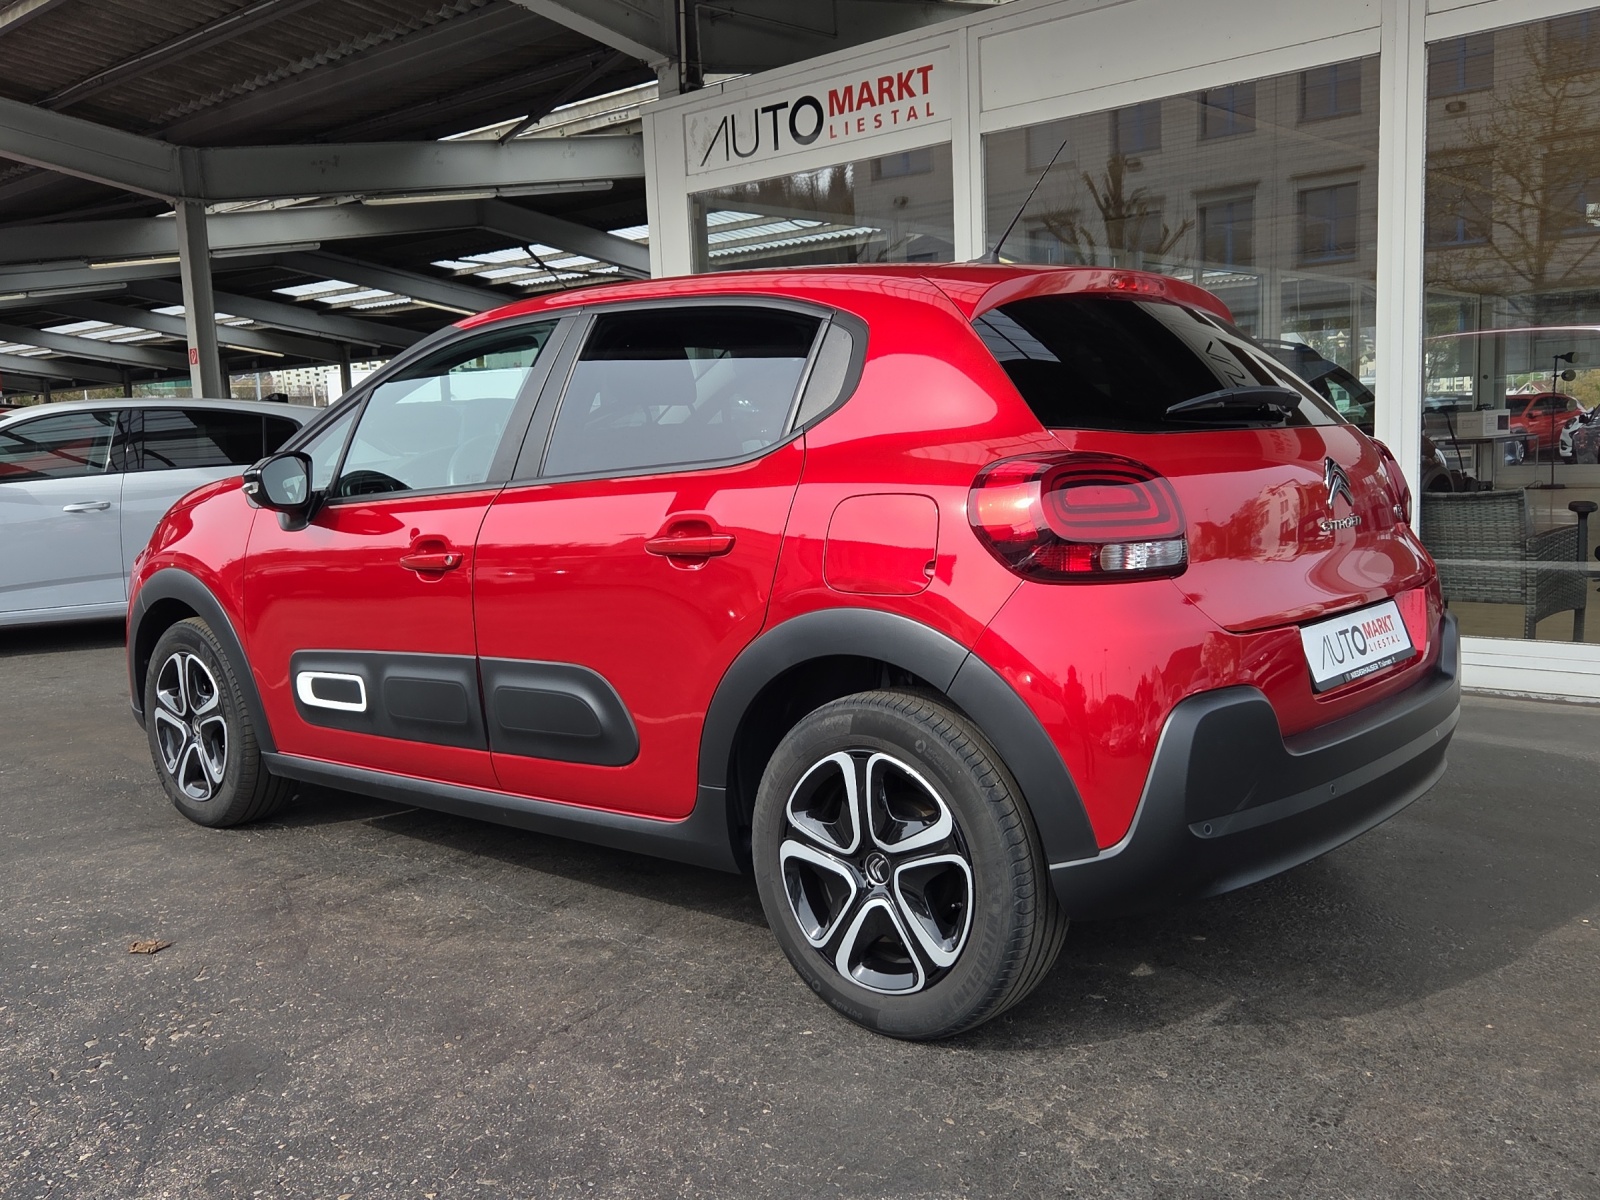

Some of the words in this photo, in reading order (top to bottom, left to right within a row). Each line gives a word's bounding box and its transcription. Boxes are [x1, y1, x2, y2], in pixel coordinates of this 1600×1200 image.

[700, 95, 824, 167] AUTO
[828, 64, 934, 117] MARKT
[829, 102, 935, 139] LIESTAL
[1322, 625, 1367, 670] AUTO
[1361, 615, 1395, 639] MARKT
[1368, 634, 1400, 652] LIESTAL
